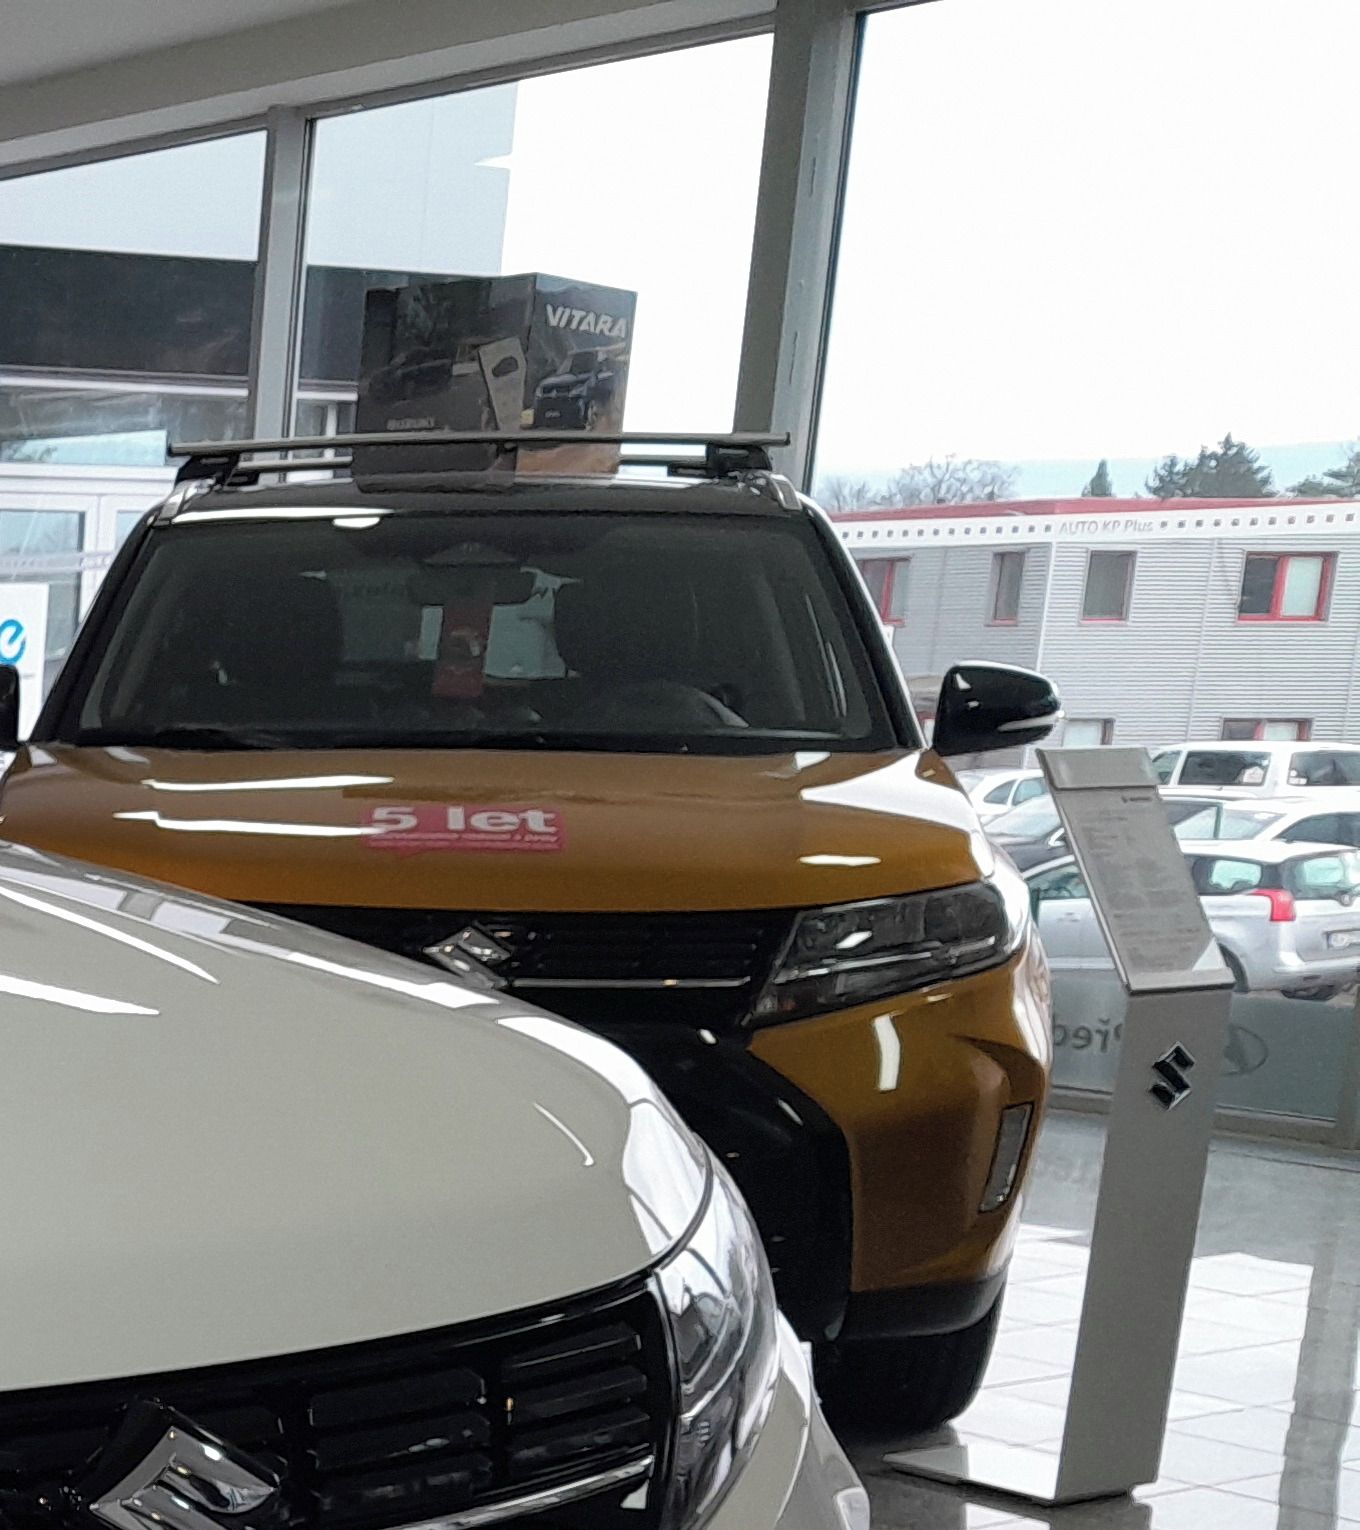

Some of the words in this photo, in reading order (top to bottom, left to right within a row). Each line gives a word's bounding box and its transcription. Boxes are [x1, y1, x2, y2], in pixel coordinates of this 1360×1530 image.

[545, 303, 628, 339] VITARA
[1060, 520, 1099, 536] AUTO
[1102, 520, 1121, 532] KP
[1124, 519, 1154, 532] Plus
[371, 806, 418, 833] 5
[446, 805, 560, 834] let
